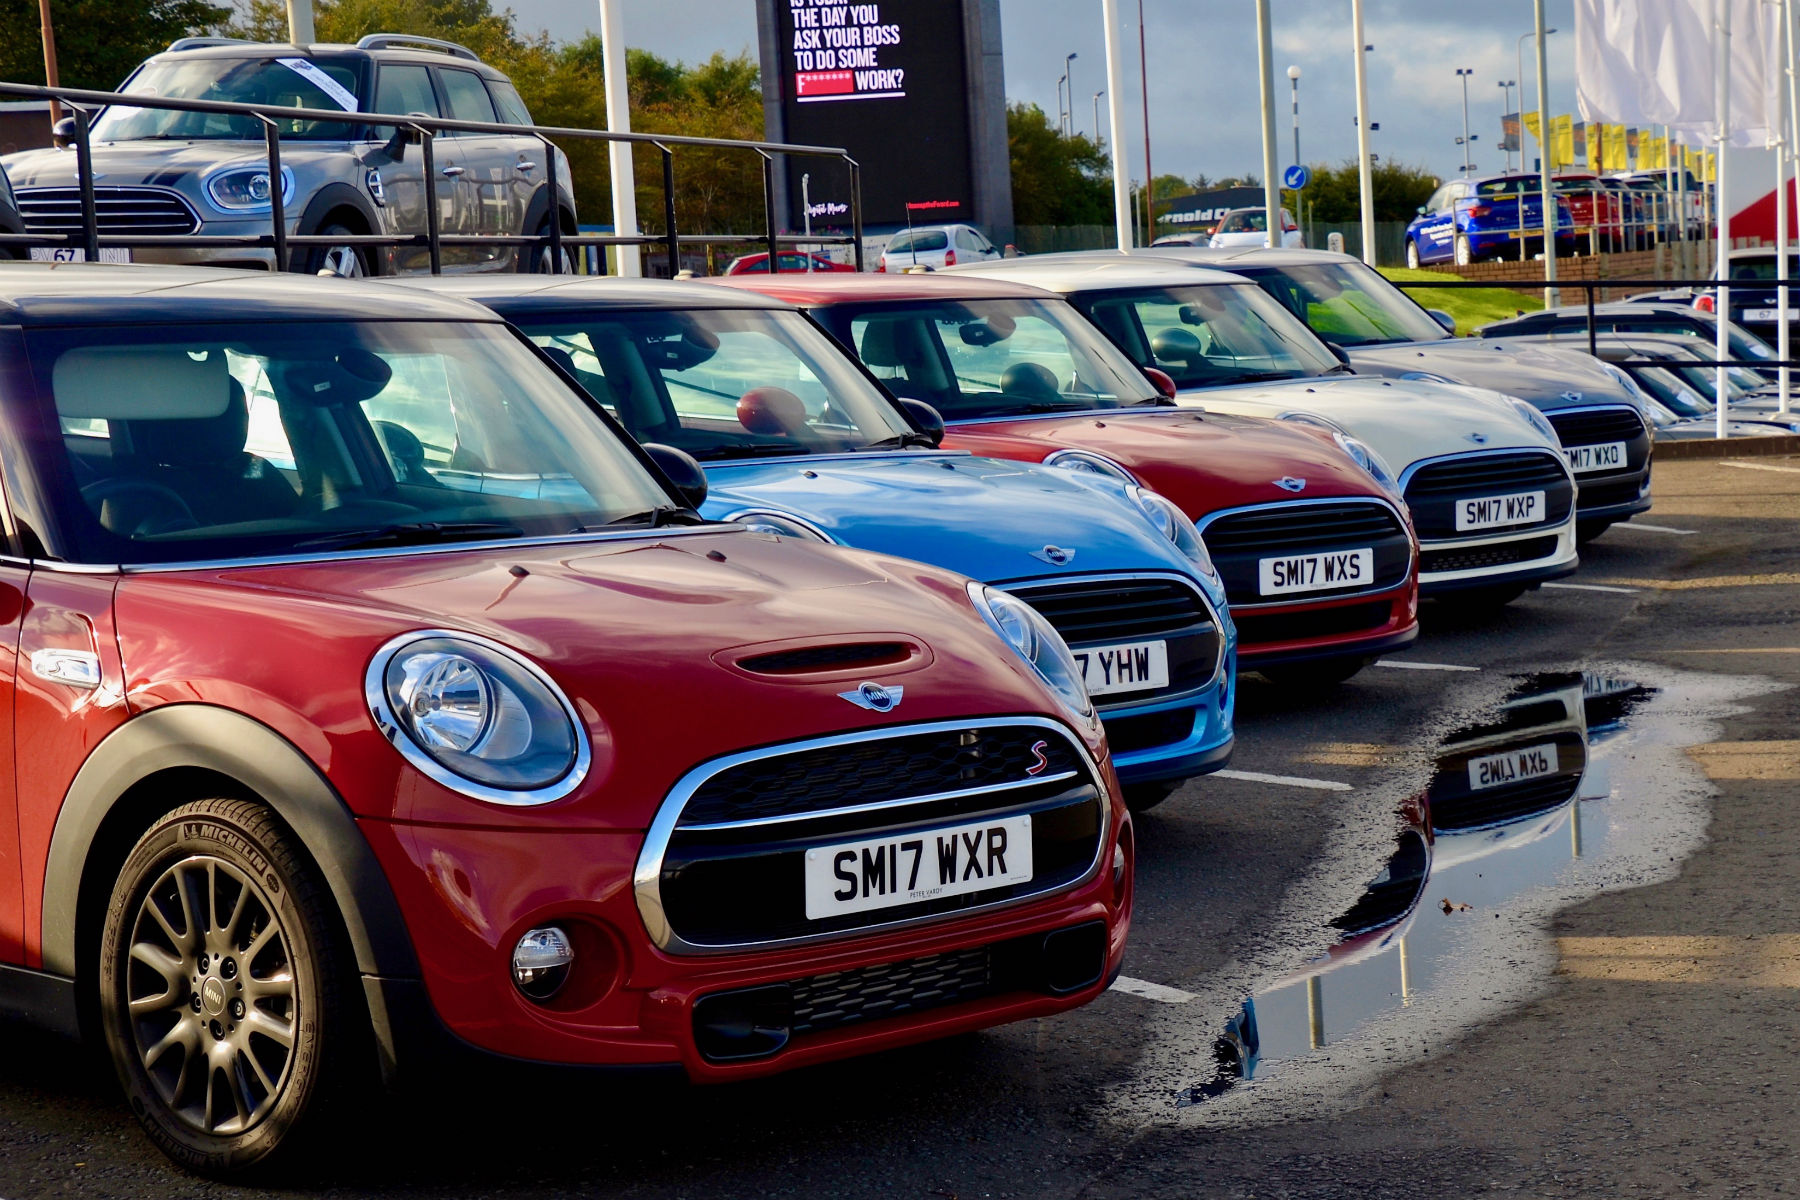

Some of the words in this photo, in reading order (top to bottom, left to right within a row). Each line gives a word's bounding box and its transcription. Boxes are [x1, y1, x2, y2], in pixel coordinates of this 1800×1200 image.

[791, 8, 819, 28] THE
[821, 6, 847, 26] DAY
[849, 4, 878, 25] YOU
[793, 29, 821, 49] ASK
[823, 27, 861, 48] YOUR
[863, 24, 900, 46] BOSS
[794, 51, 813, 70] TO
[816, 49, 836, 70] DO
[838, 47, 878, 69] SOME
[855, 68, 904, 90] WORK?
[1466, 499, 1501, 524] SM17
[1507, 495, 1534, 519] WXP
[1273, 557, 1317, 587] SM17
[1324, 554, 1360, 582] WXS
[1099, 647, 1149, 685] YHW
[865, 690, 889, 701] MINI
[1025, 740, 1047, 775] S
[200, 824, 267, 871] MICHELIN
[833, 839, 923, 902] SM17
[937, 826, 1008, 885] WXR
[205, 986, 221, 1005] MINI
